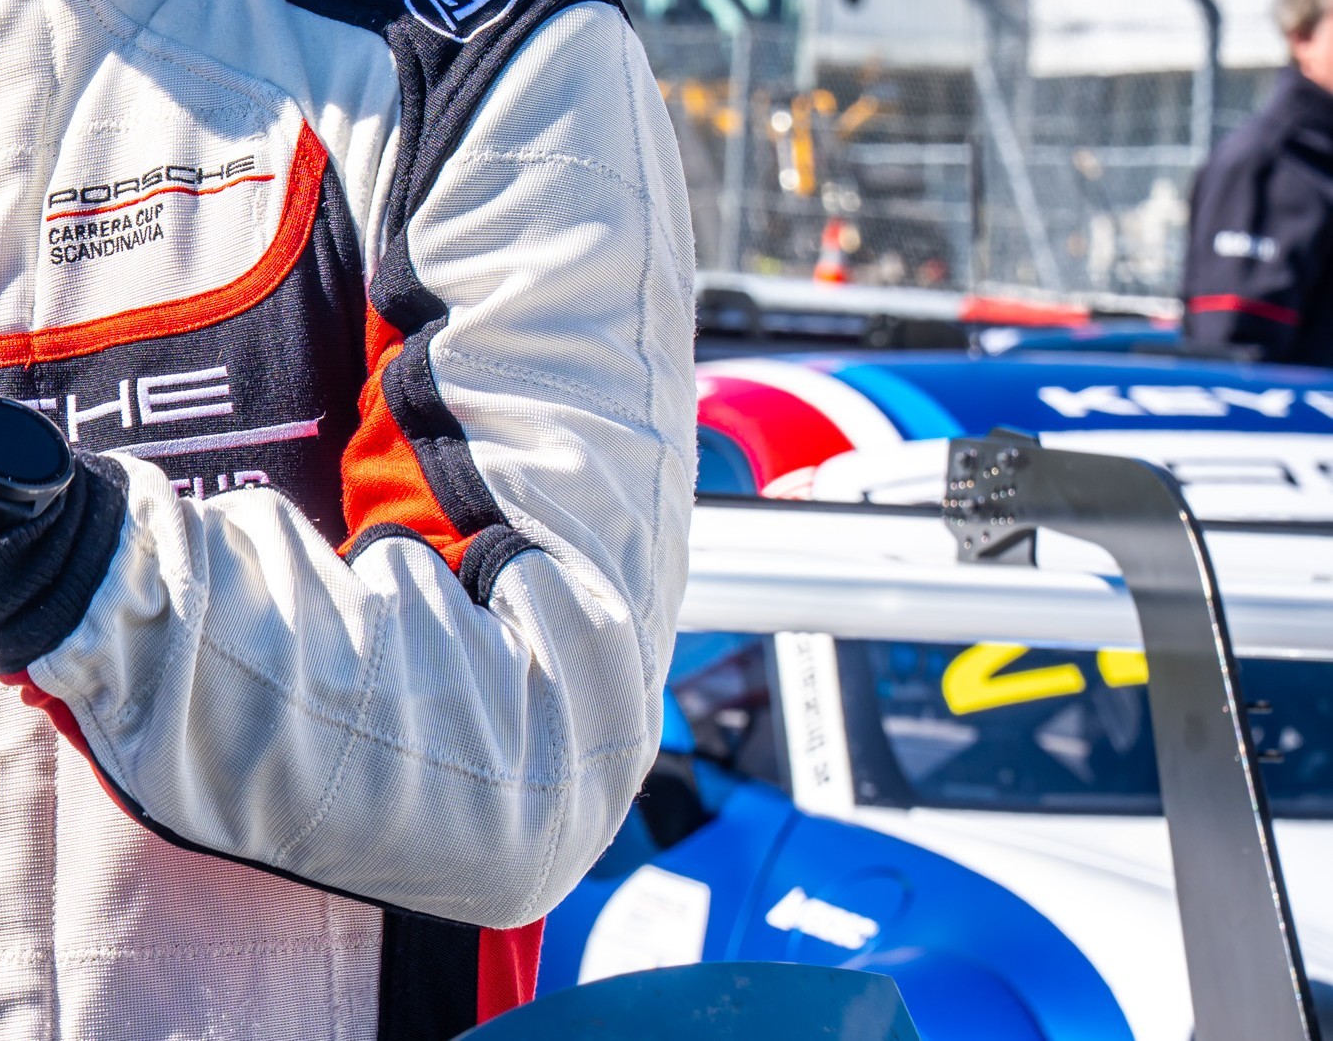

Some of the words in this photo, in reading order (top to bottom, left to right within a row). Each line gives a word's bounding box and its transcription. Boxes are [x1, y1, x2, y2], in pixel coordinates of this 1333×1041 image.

[47, 154, 255, 209] PORSCHE
[48, 216, 134, 245] CARRERA
[135, 203, 164, 227] CUP
[50, 222, 165, 265] SCANDINAVIA
[1037, 385, 1333, 418] KEY
